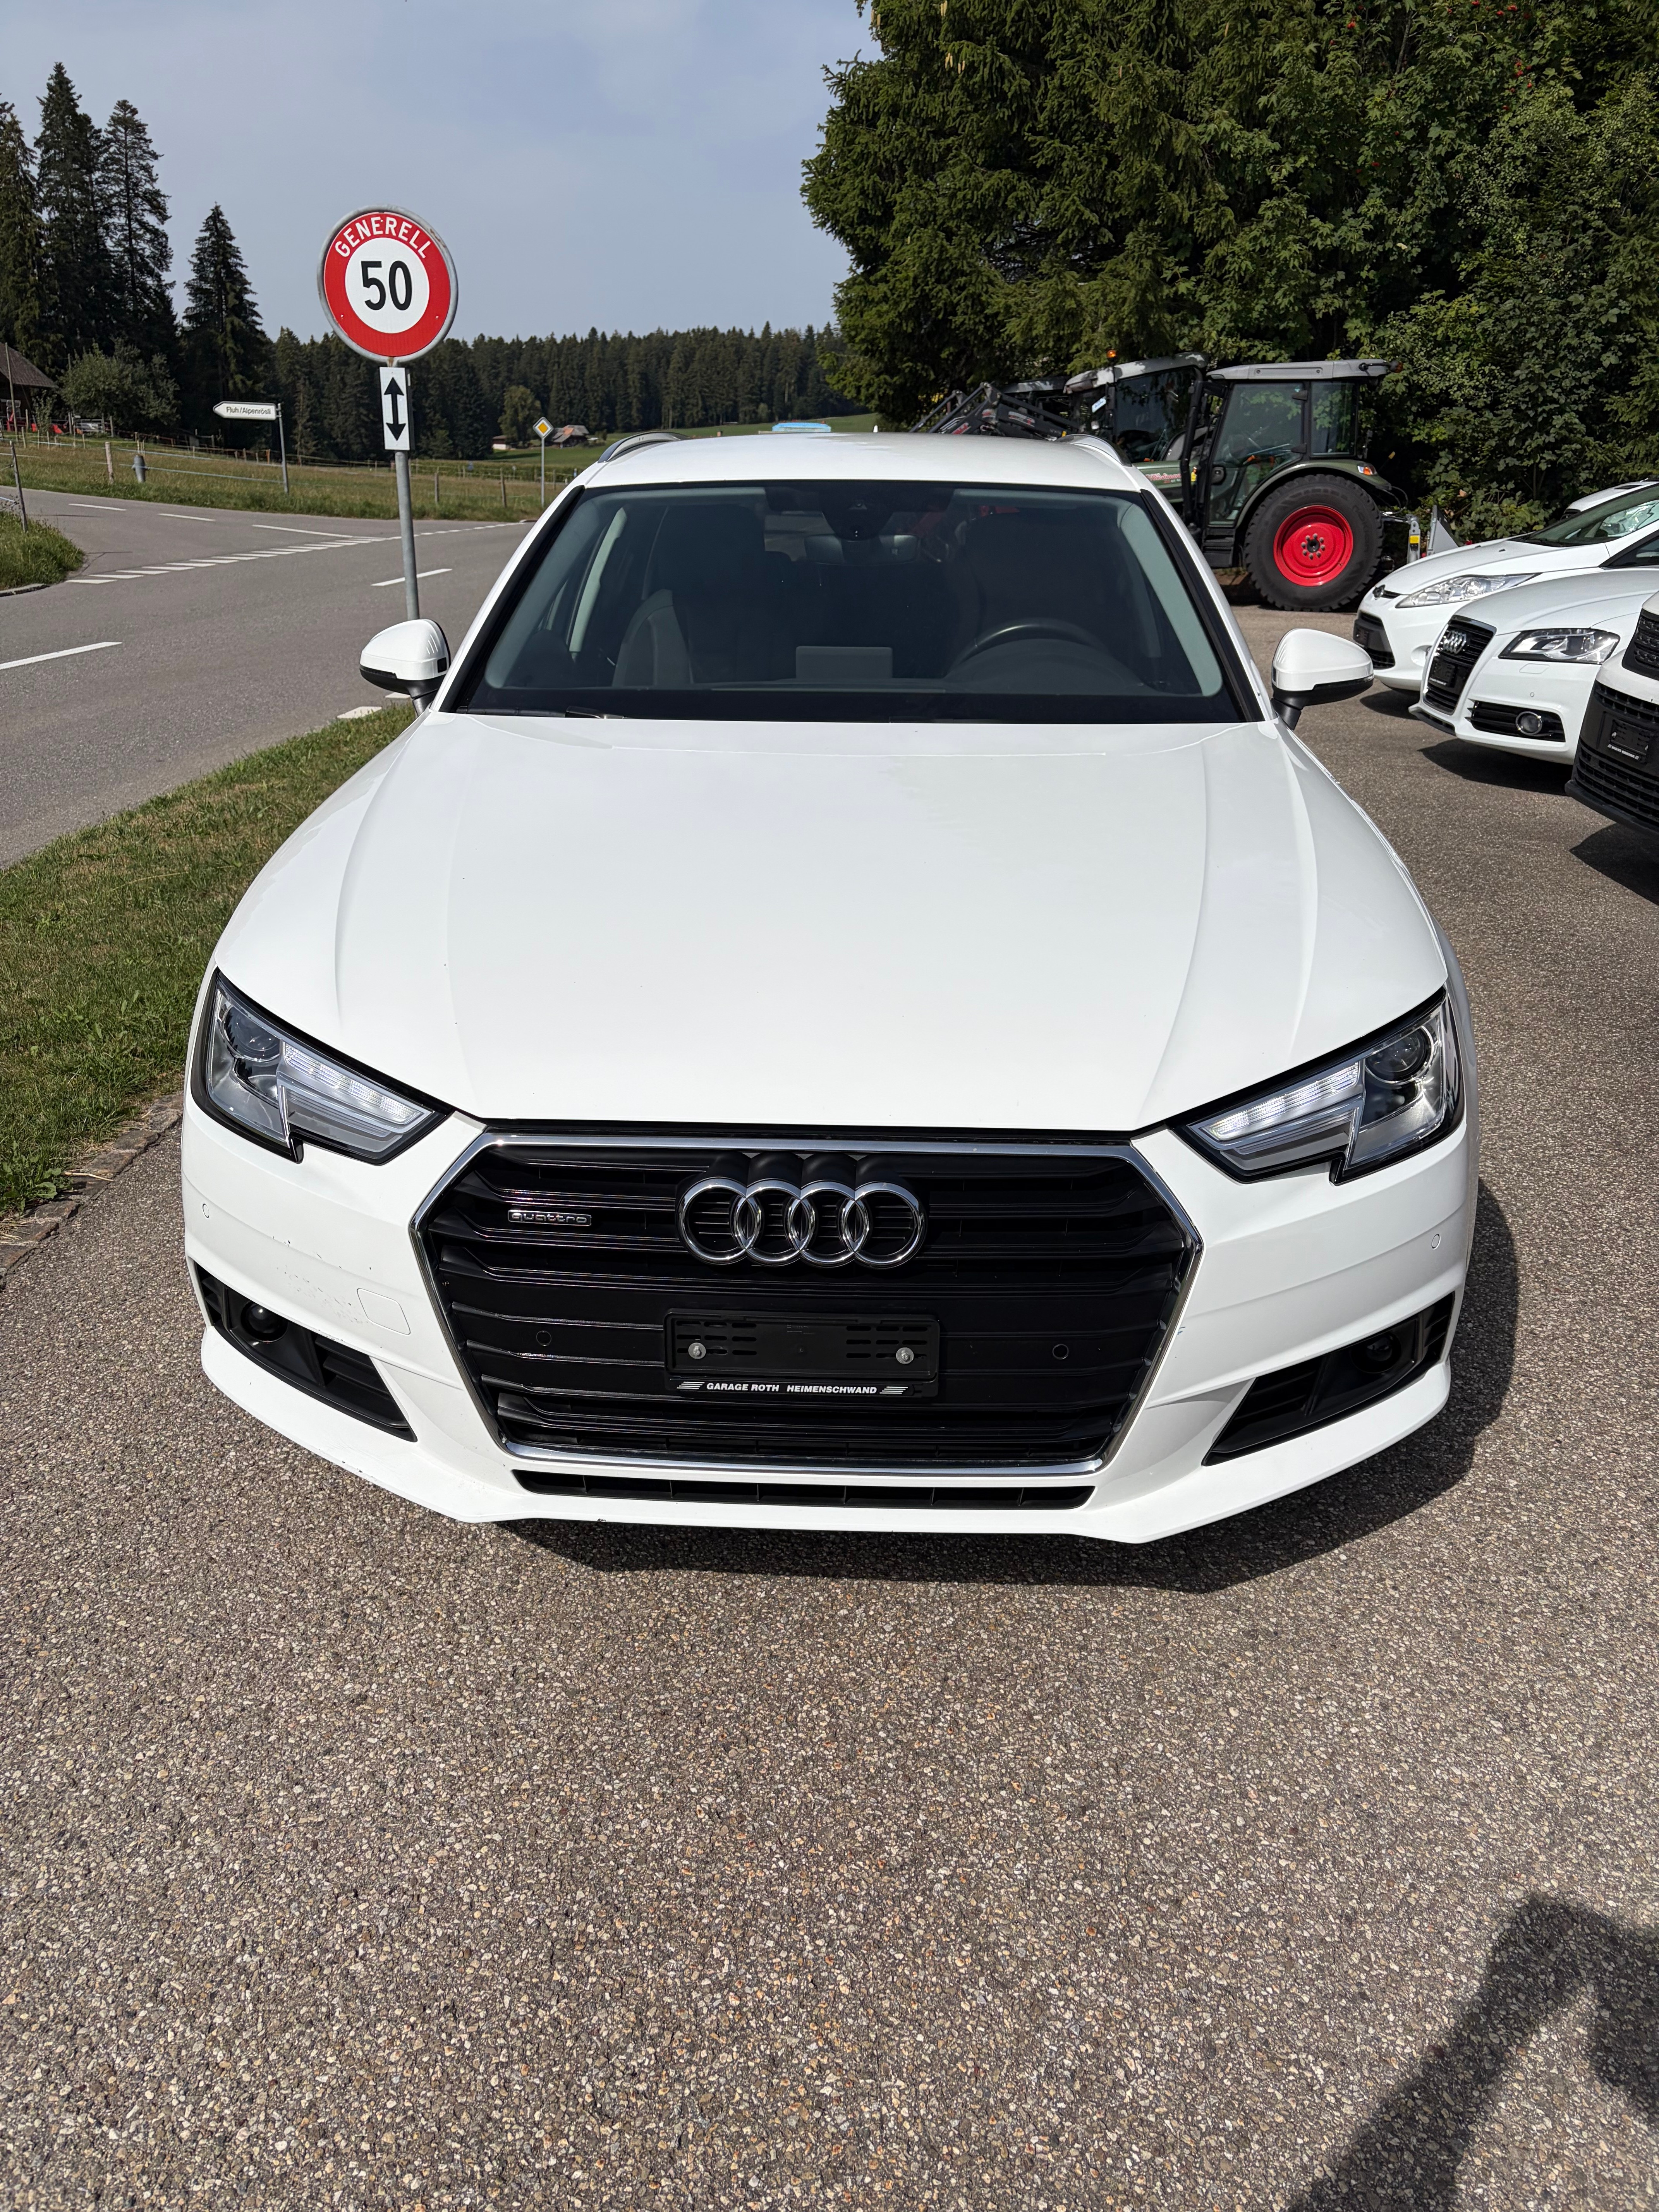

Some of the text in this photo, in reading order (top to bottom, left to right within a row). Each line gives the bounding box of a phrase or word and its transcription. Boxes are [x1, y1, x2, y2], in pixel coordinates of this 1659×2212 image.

[335, 217, 431, 258] GENERELL
[361, 260, 412, 311] 50
[512, 1212, 587, 1223] quattro
[787, 1385, 877, 1394] HEIMENSCHWAND
